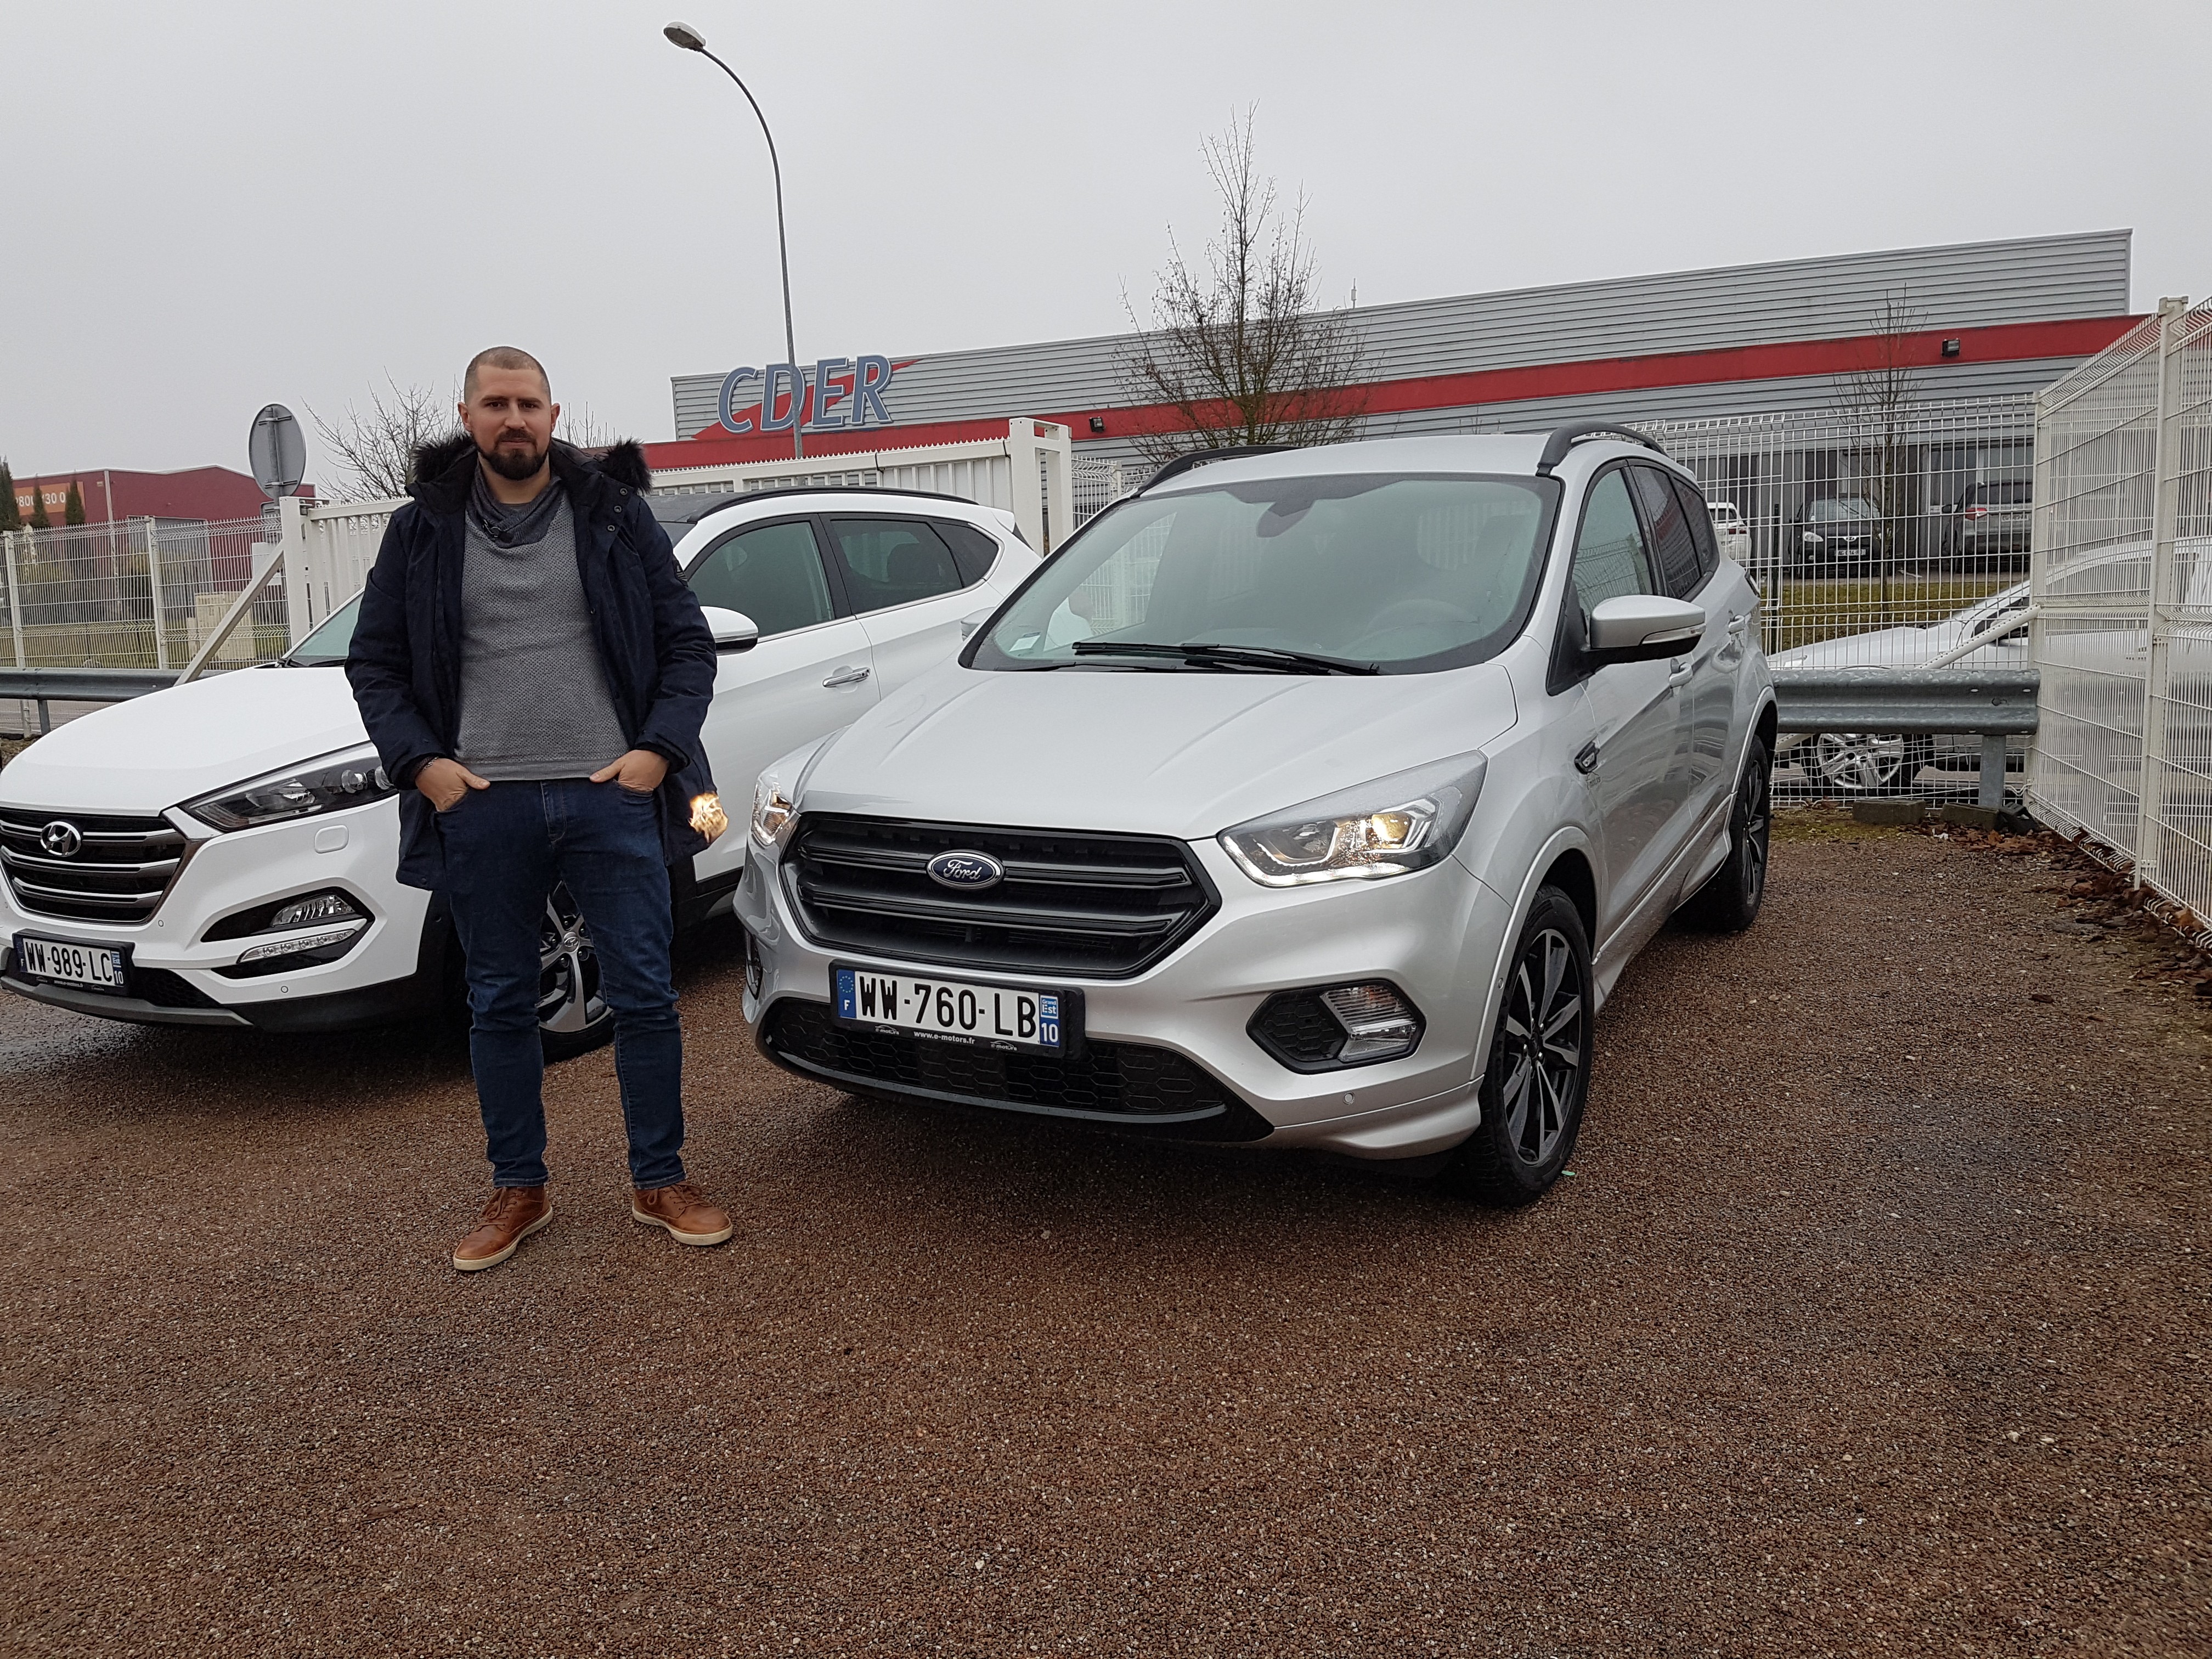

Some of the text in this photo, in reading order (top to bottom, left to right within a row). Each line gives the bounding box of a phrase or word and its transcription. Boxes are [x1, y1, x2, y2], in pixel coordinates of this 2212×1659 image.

[717, 354, 894, 433] CDER
[943, 859, 983, 880] Ford
[25, 941, 112, 982] WW-989-LC
[114, 970, 123, 984] 10
[844, 1000, 850, 1011] F
[860, 976, 1036, 1038] WW-760-LB
[1042, 1005, 1057, 1014] Est
[914, 1031, 975, 1045] www.e-motors.fr
[1041, 1023, 1058, 1042] 10
